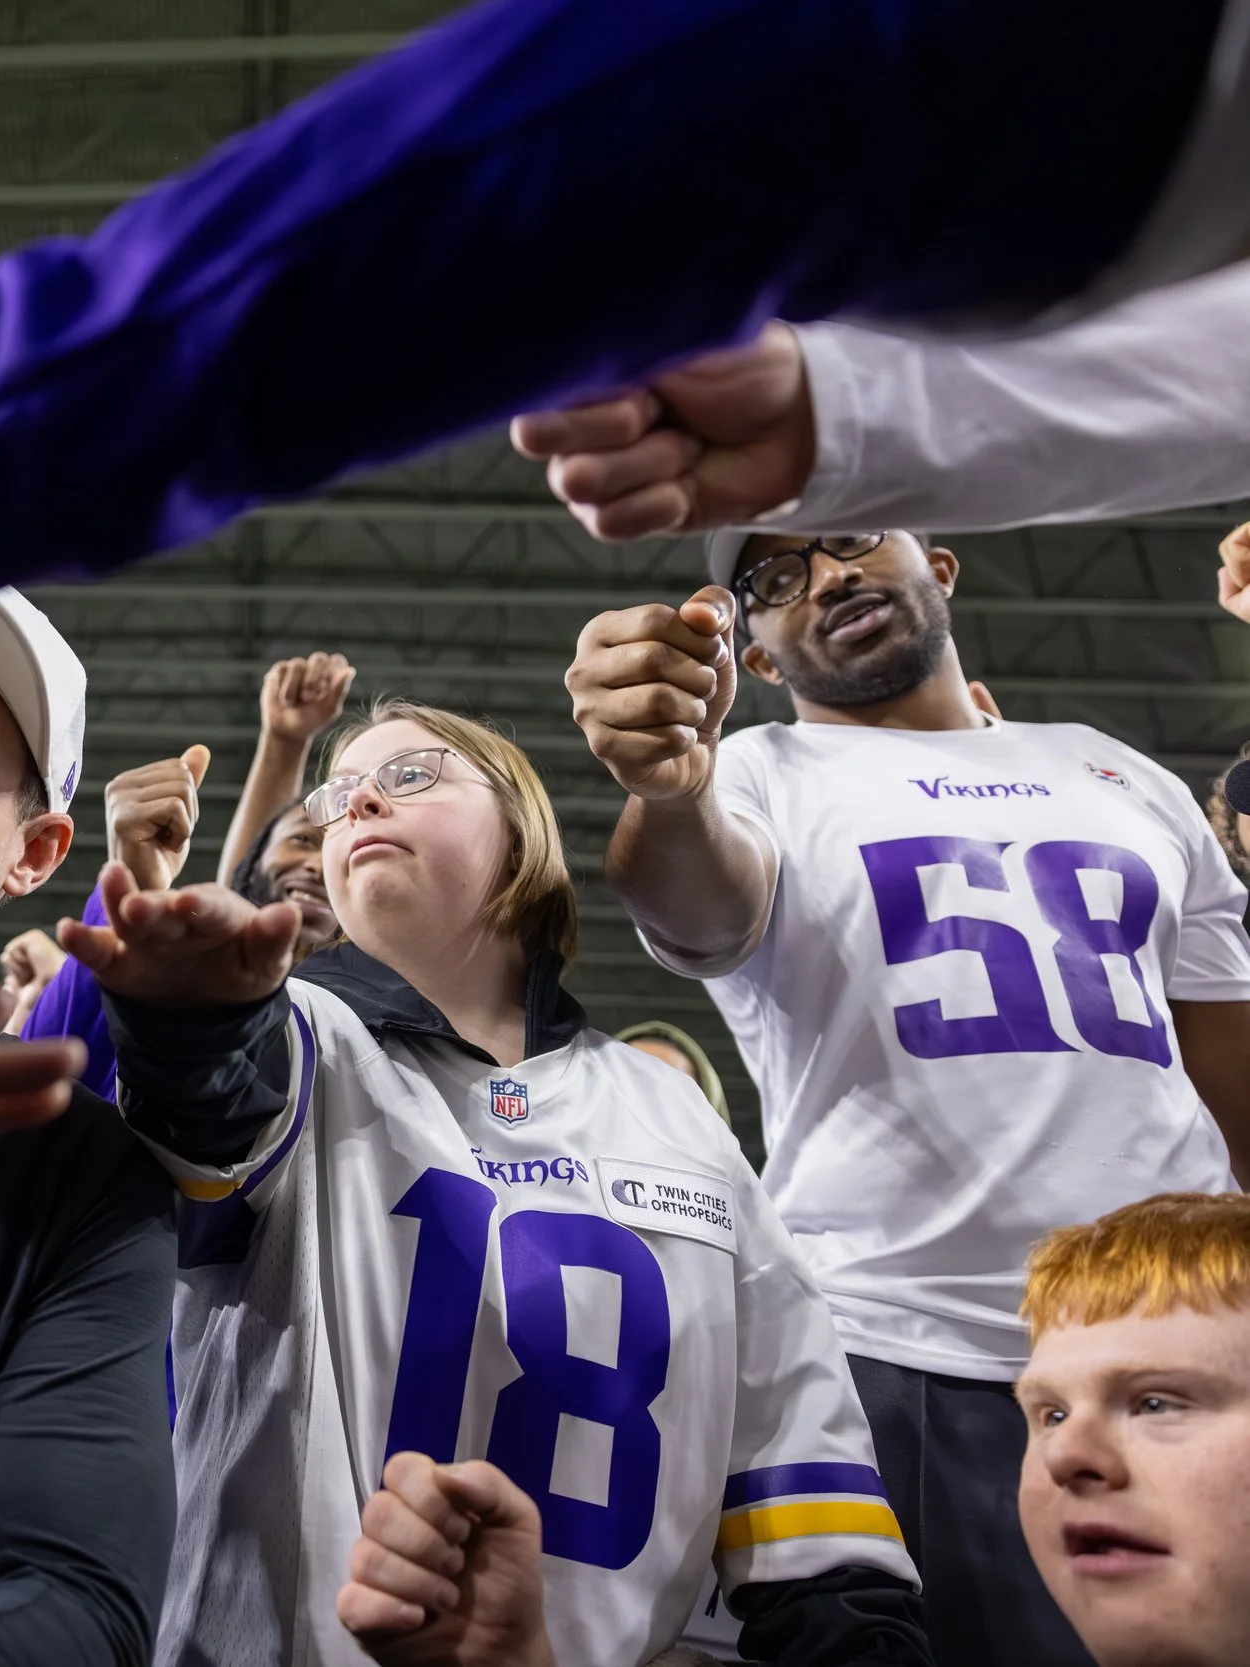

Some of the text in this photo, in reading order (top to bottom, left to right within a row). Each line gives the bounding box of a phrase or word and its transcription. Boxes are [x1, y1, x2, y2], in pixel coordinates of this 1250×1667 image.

[859, 836, 1173, 1069] 58
[495, 1095, 526, 1118] NFL
[654, 1184, 728, 1213] TWIN CITIES
[651, 1199, 733, 1231] ORTHOPEDICS
[380, 1167, 671, 1570] 18
